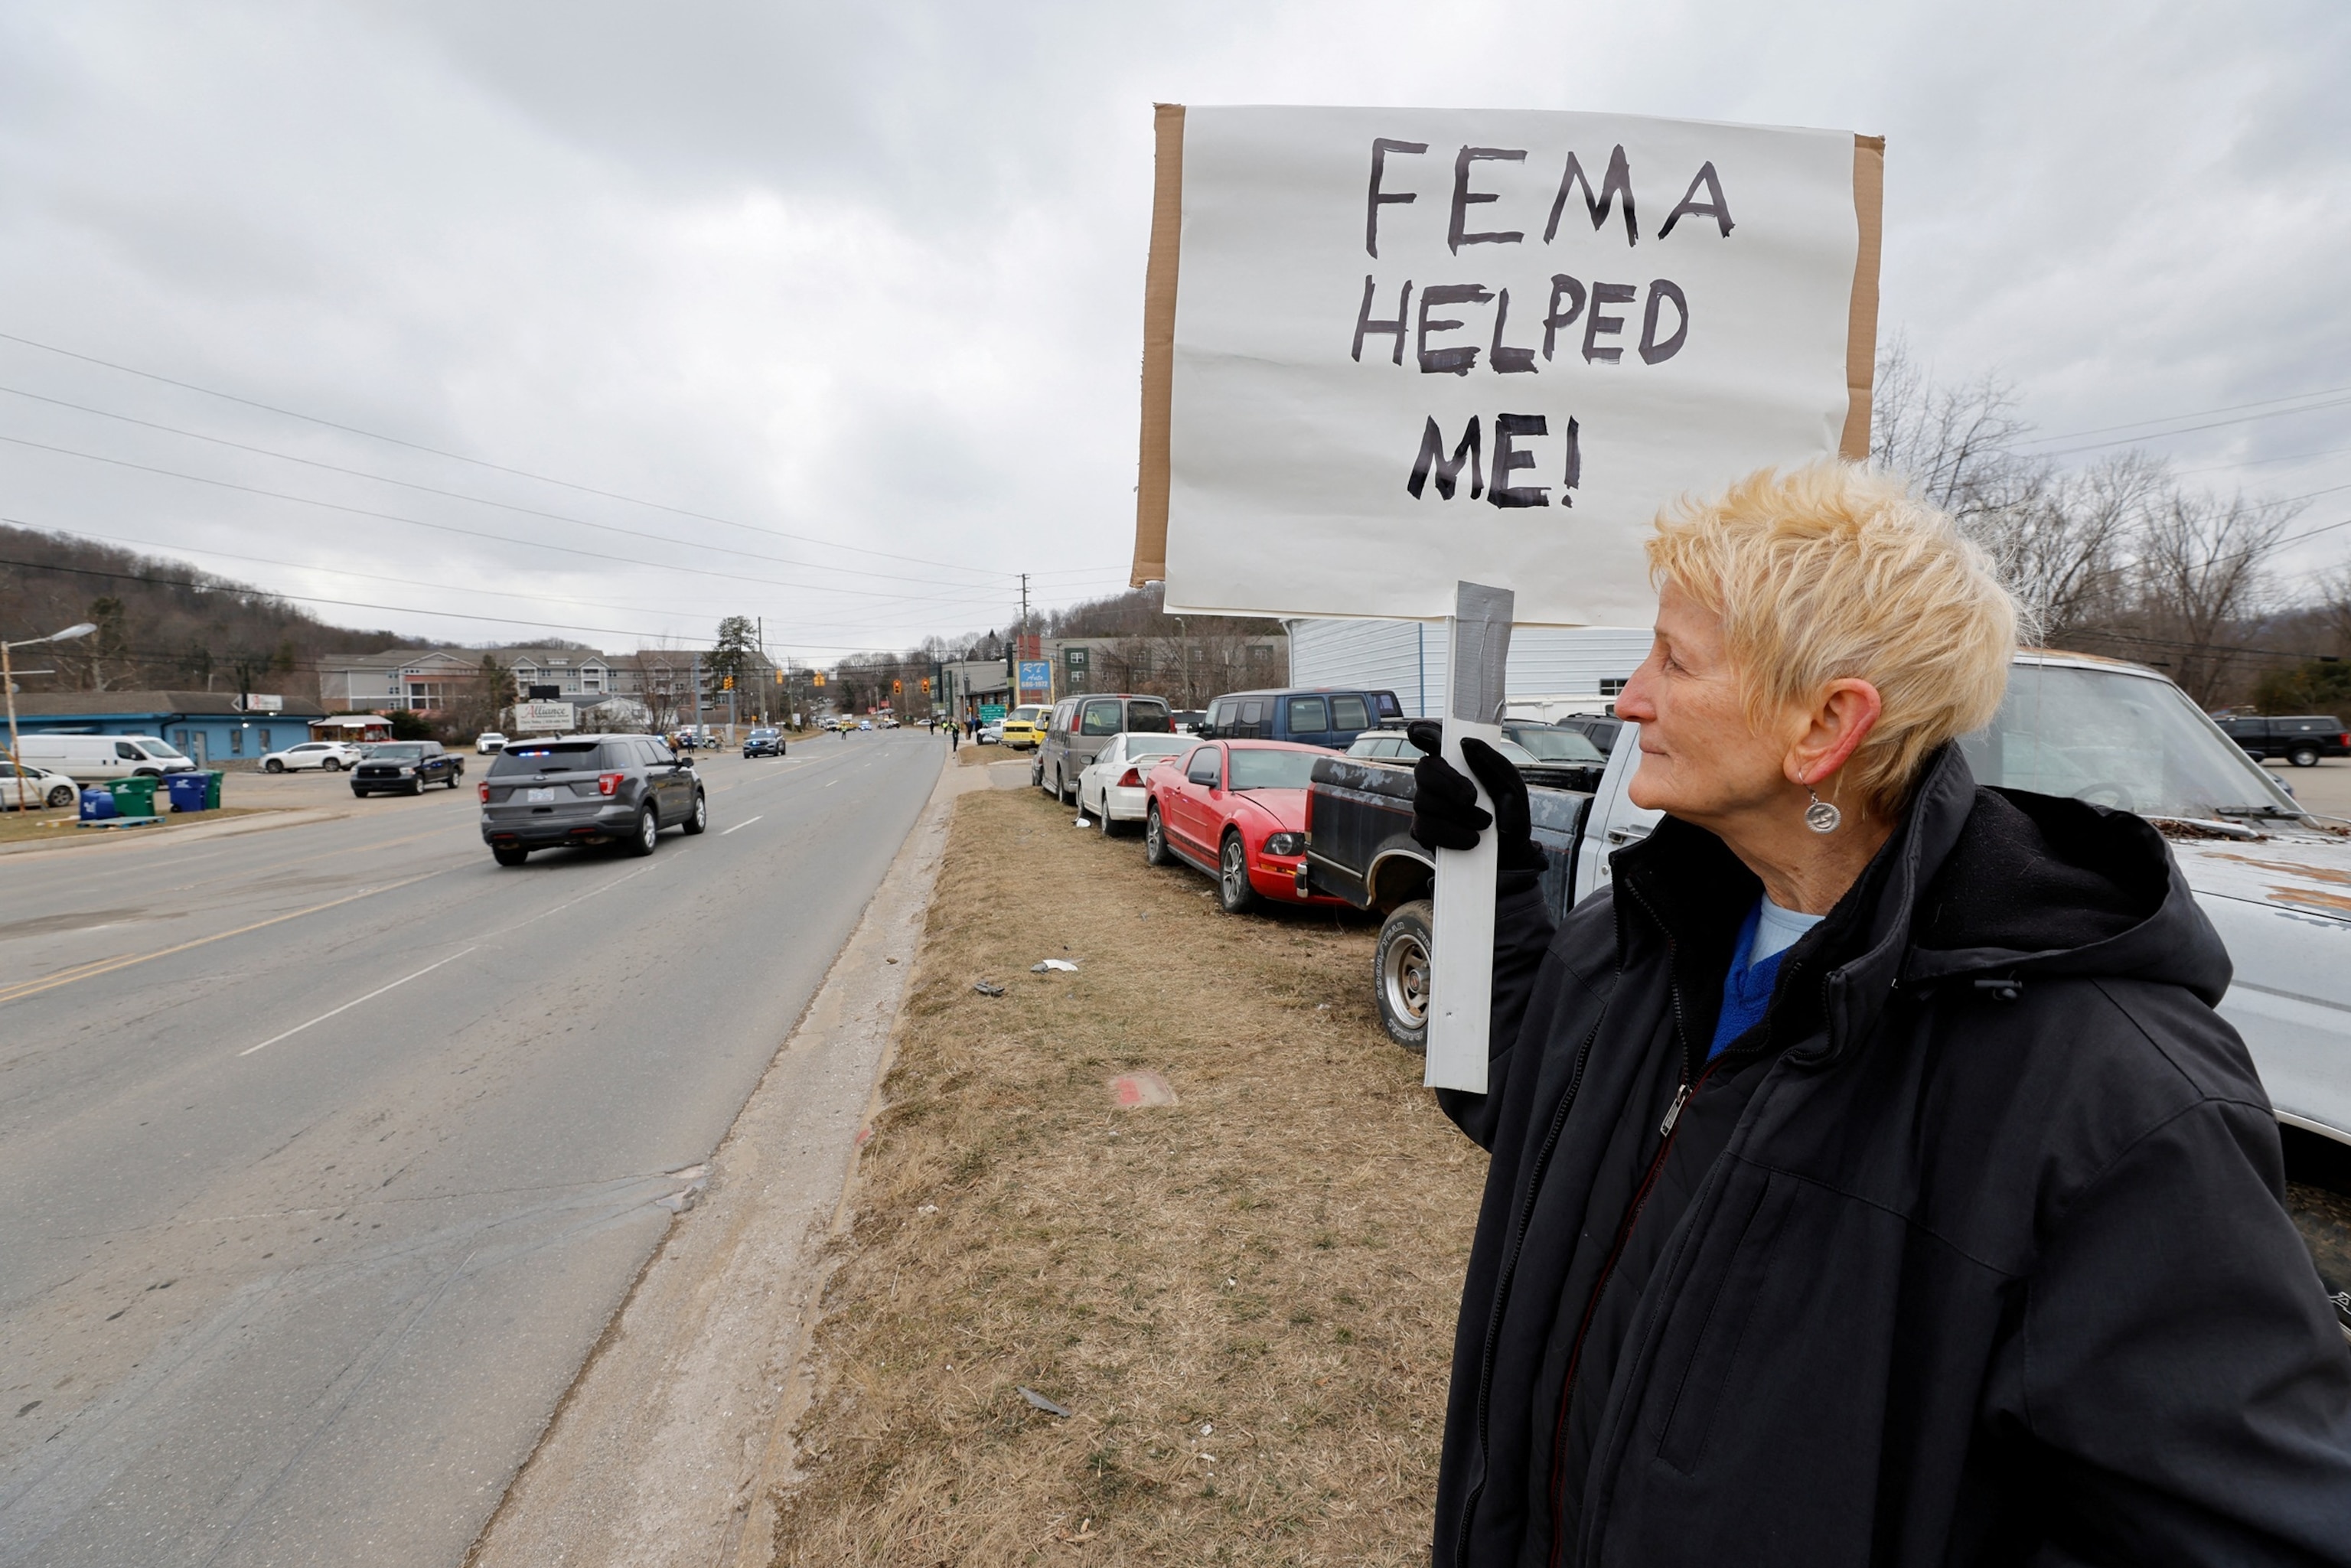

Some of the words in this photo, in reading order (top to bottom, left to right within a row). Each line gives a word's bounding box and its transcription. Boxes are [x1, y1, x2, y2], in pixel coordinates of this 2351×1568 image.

[1366, 138, 1736, 259] FEMA
[1352, 273, 1689, 377] HELPED
[1407, 412, 1580, 509] ME!
[521, 705, 566, 719] Alliance
[1376, 921, 1405, 999] GOODYEAR
